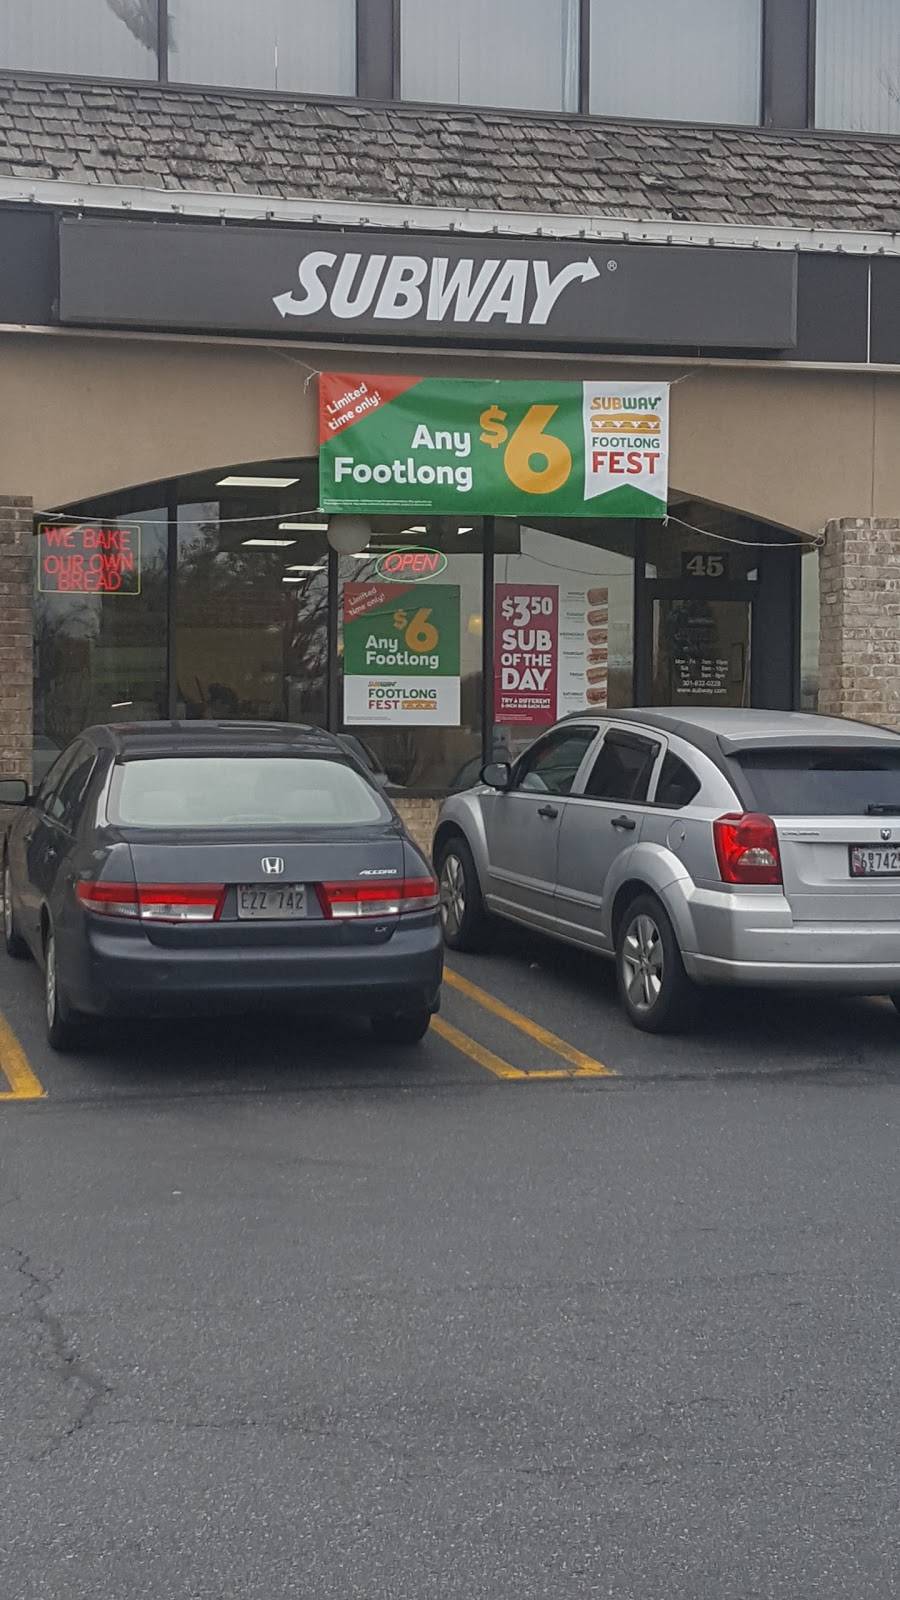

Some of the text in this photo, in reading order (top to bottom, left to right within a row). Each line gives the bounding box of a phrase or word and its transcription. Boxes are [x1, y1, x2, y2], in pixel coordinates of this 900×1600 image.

[272, 250, 600, 325] SUBWAY
[326, 382, 368, 414] Limited
[590, 396, 662, 411] SUBWAY
[328, 391, 382, 431] time only!
[410, 424, 472, 456] Any
[479, 404, 572, 494] $6
[592, 436, 660, 449] FOOTLONG
[592, 451, 660, 474] FEST
[333, 456, 474, 493] Footlong
[44, 527, 131, 550] WE BAKE
[44, 552, 134, 575] OUR OWN
[383, 552, 440, 574] OPEN
[686, 555, 724, 577] 45
[57, 571, 122, 592] BREAD
[348, 586, 378, 606] Limited
[348, 593, 386, 616] time only!
[393, 607, 439, 653] $6
[502, 629, 552, 652] SUB
[365, 634, 399, 653] Any
[366, 651, 439, 669] Footlong
[501, 653, 522, 667] OF
[522, 653, 552, 668] THE
[501, 667, 552, 691] DAY
[368, 689, 437, 699] FOOTLONG
[368, 700, 400, 710] FEST
[276, 891, 303, 909] 742
